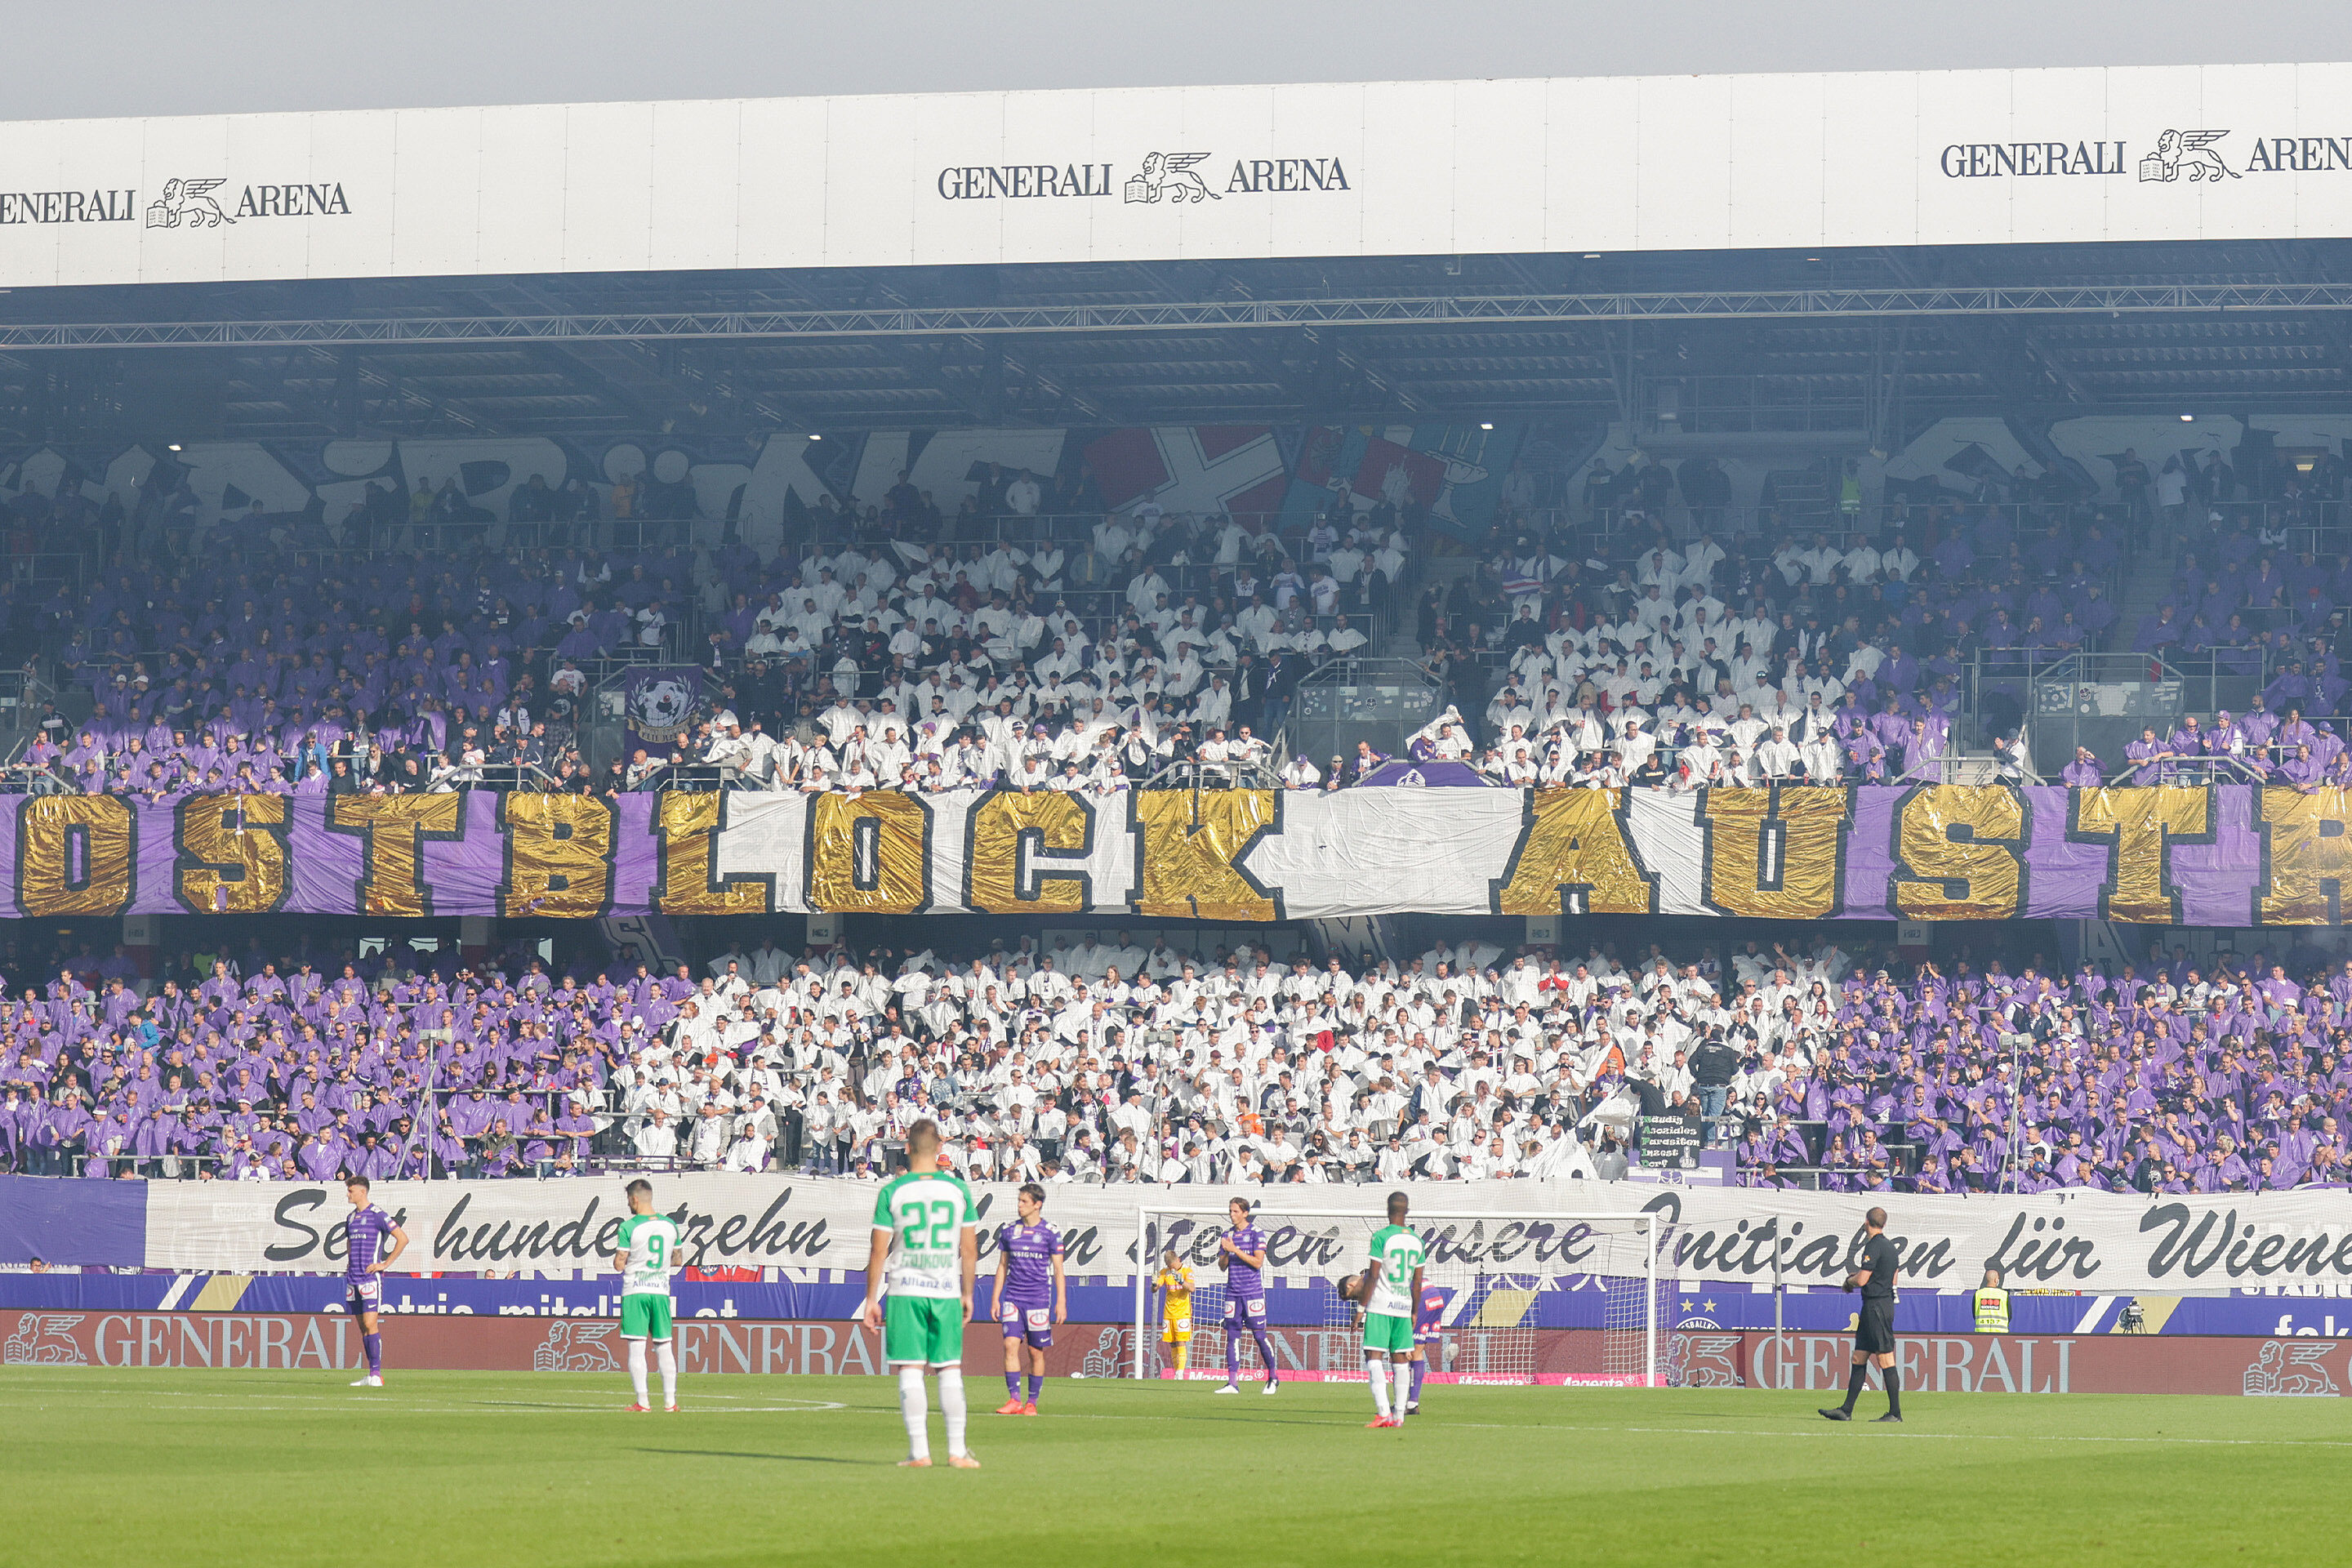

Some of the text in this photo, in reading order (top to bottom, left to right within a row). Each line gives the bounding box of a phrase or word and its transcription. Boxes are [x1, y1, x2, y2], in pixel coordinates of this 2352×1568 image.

[938, 163, 1114, 199] GENERALI
[1225, 157, 1351, 193] ARENA
[1940, 140, 2127, 178] GENERALI
[2245, 137, 2352, 172] AREN
[0, 189, 136, 224] ENERALI
[234, 182, 351, 217] ARENA
[14, 787, 1284, 923] OSTBLOCK
[1642, 1126, 1698, 1135] Asoziales
[1641, 1148, 1679, 1157] Inzest
[1641, 1160, 1668, 1168] Dorf
[264, 1189, 408, 1262] Set
[1980, 1211, 2101, 1290] für
[902, 1200, 955, 1250] 22
[646, 1235, 664, 1268] 9
[900, 1276, 939, 1289] Allianz
[94, 1315, 385, 1369] GENERAL
